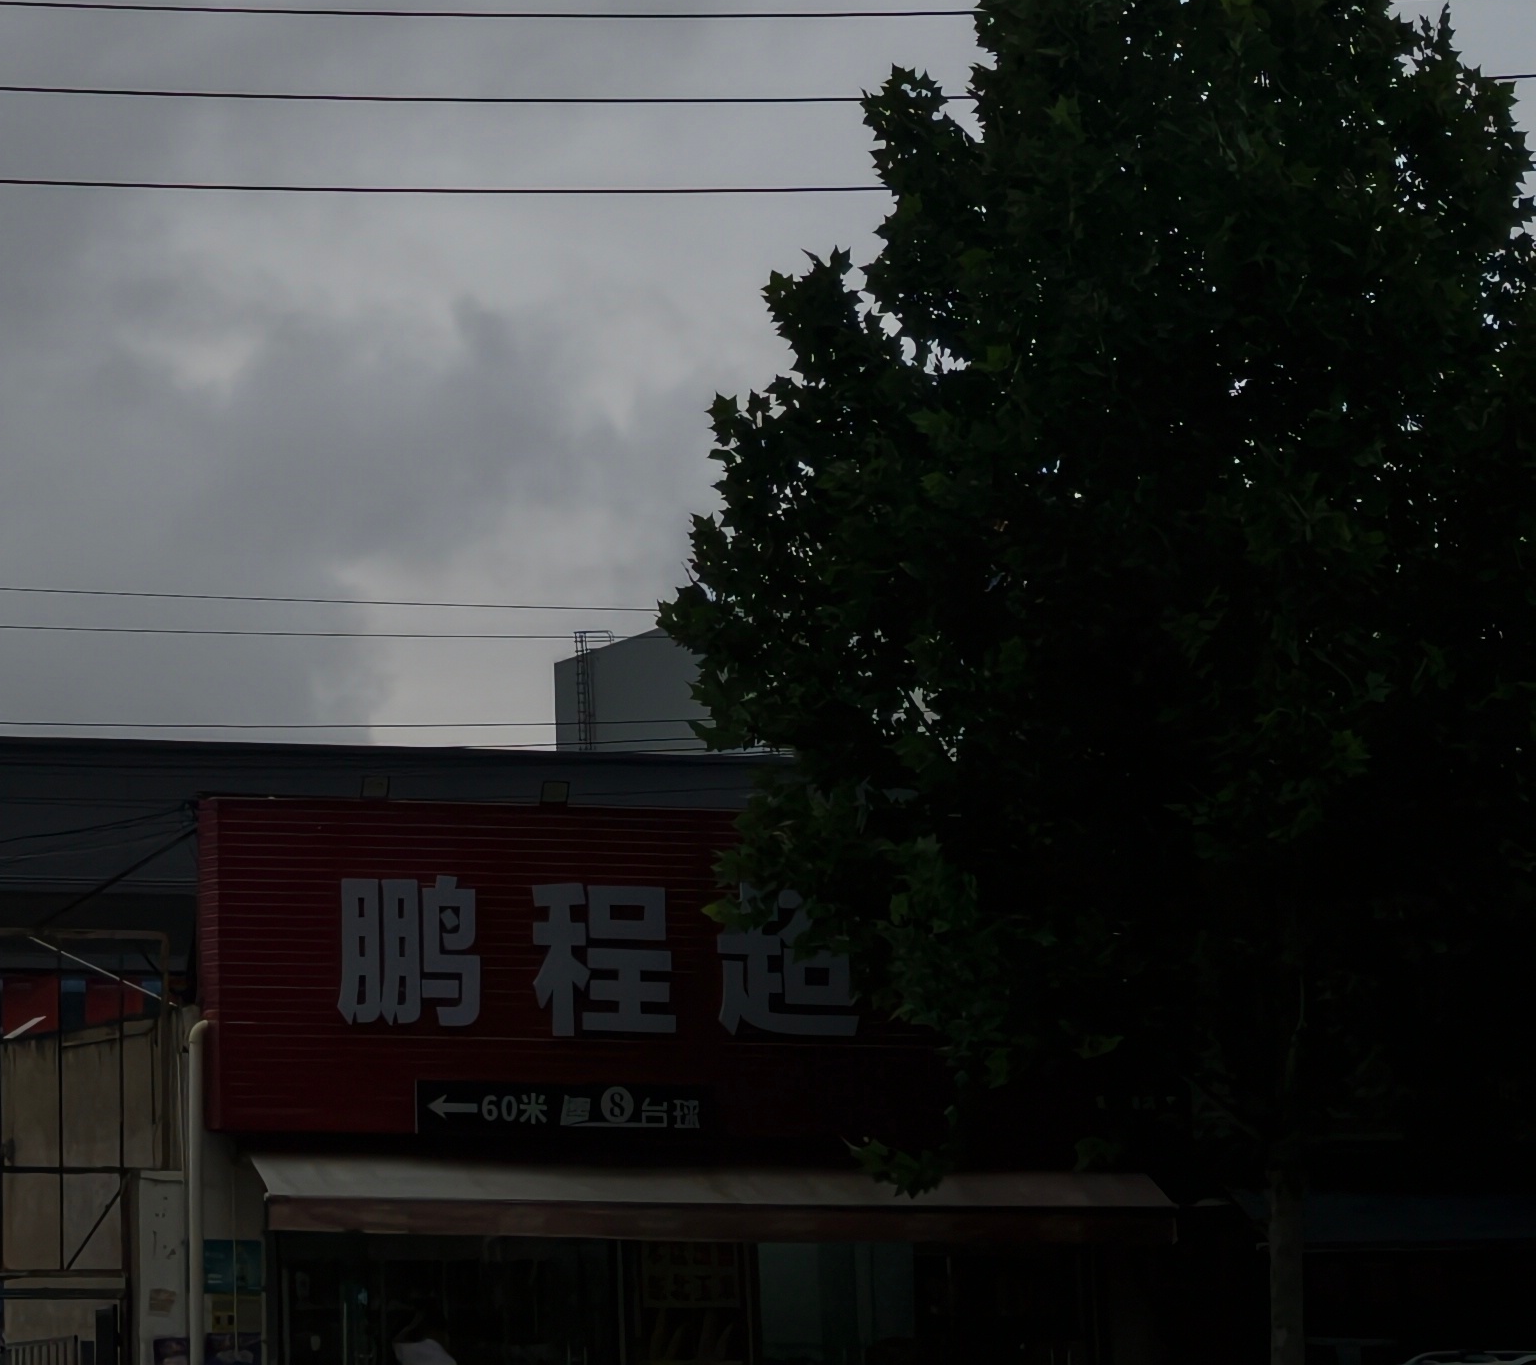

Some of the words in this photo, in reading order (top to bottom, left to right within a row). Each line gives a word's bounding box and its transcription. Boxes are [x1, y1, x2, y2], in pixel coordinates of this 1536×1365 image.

[337, 875, 861, 1037] 鹏程超
[481, 1092, 548, 1125] 60米
